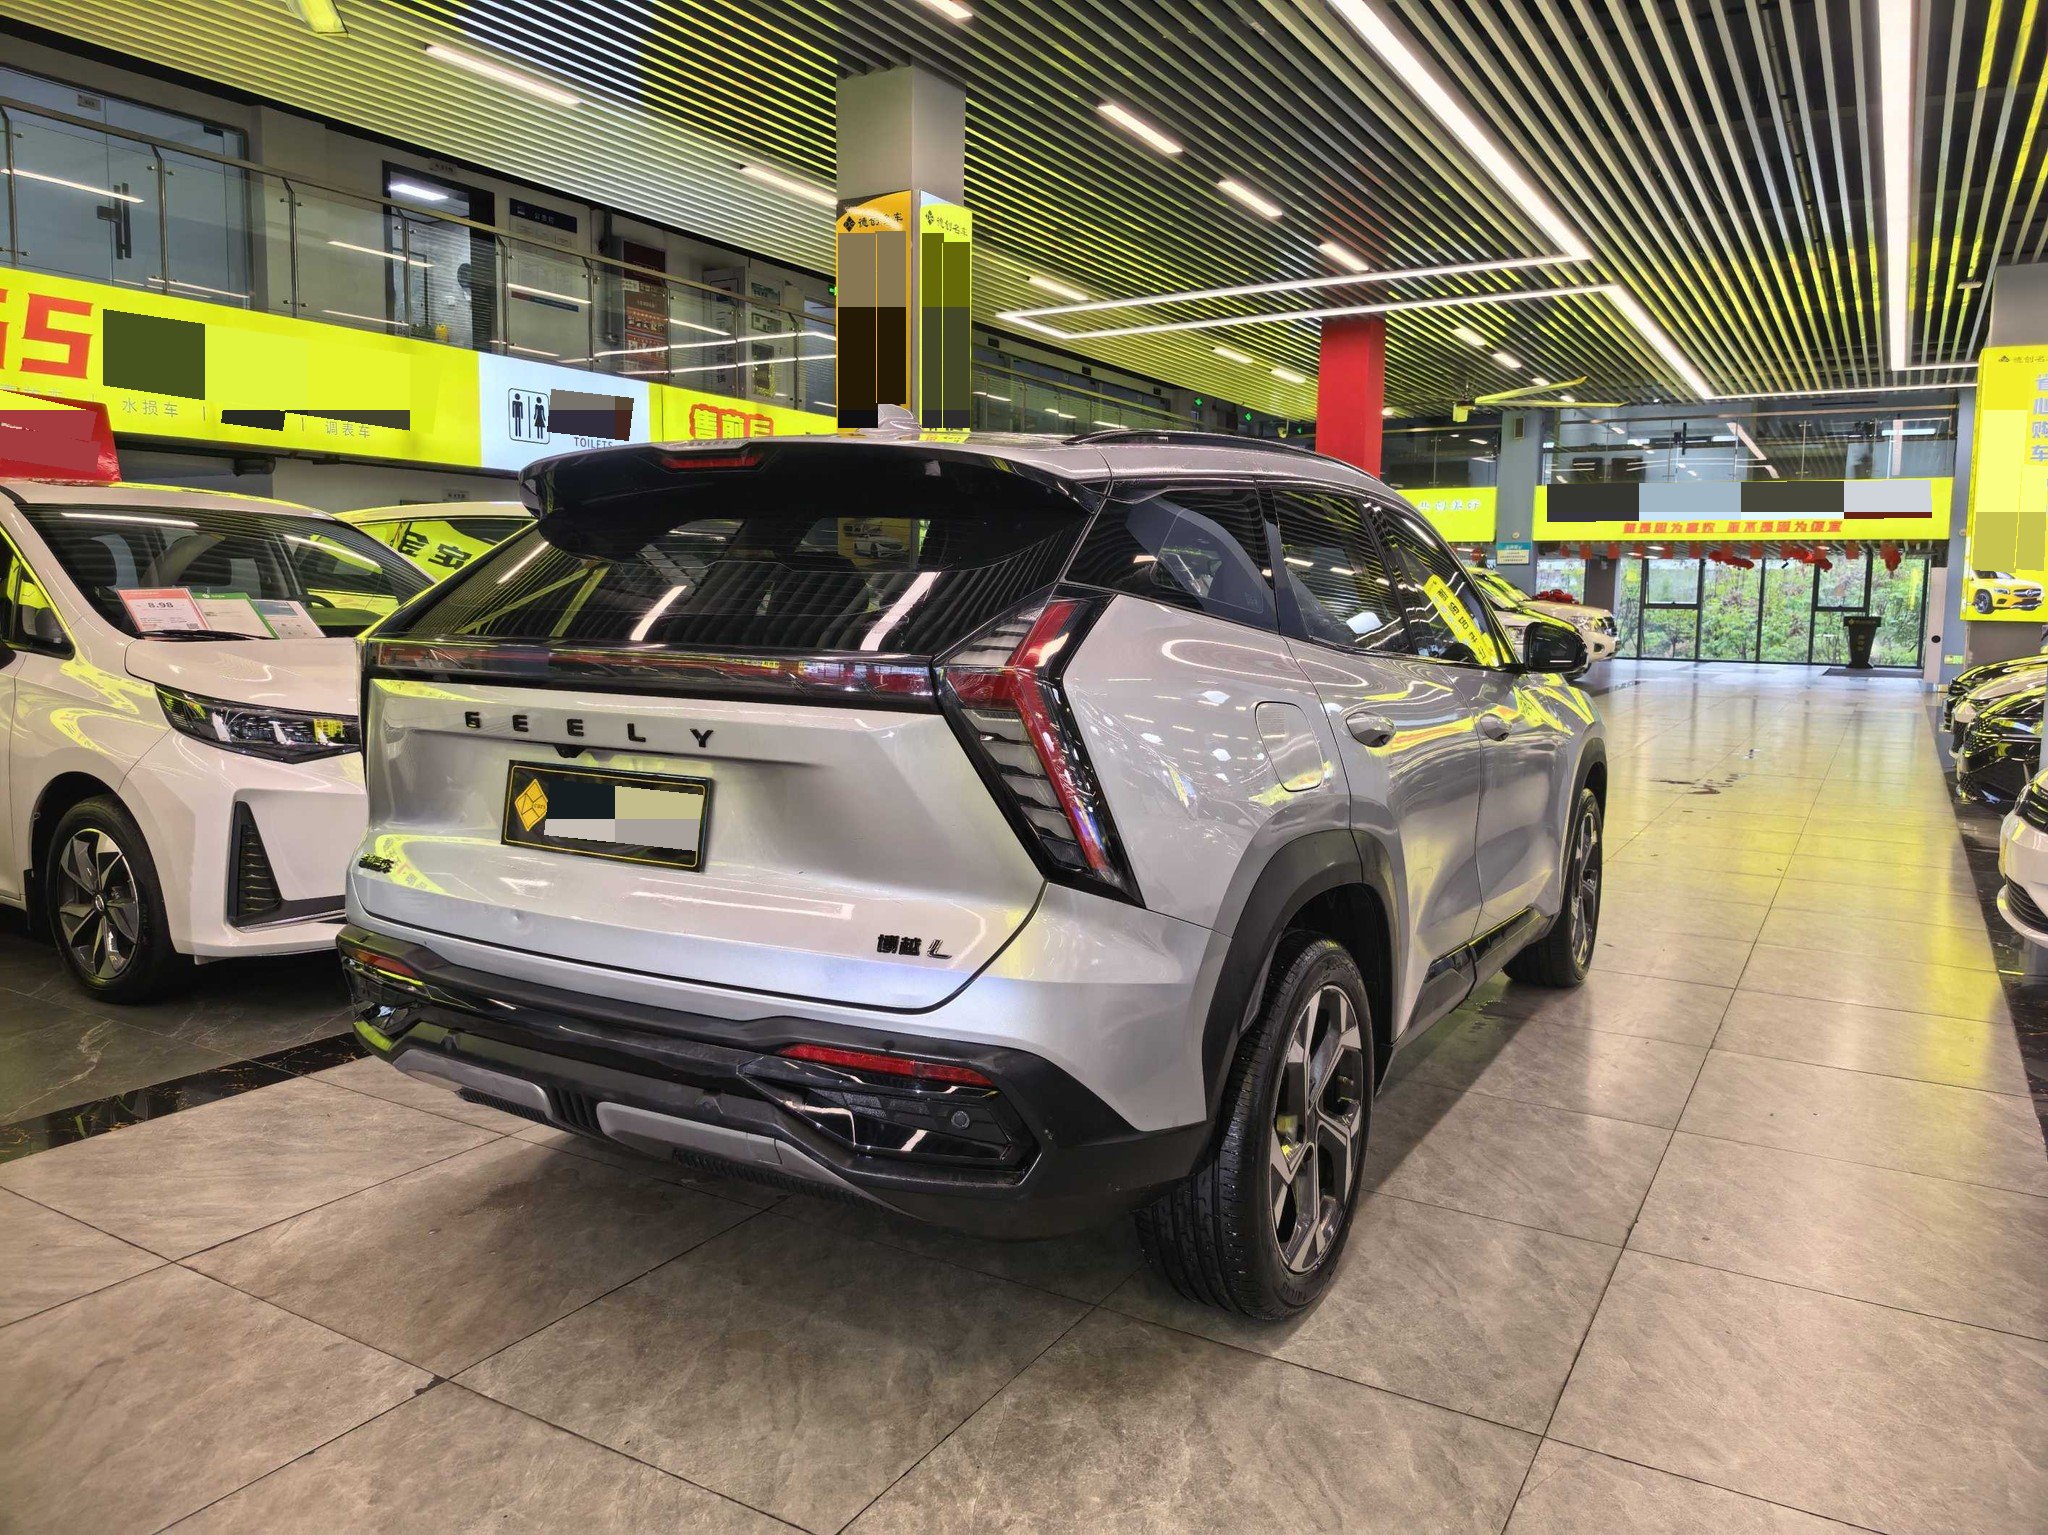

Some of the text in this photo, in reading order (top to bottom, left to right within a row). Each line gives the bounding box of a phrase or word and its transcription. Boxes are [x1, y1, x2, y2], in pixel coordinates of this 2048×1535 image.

[858, 211, 904, 229] 德创车
[122, 397, 178, 418] 水损车
[325, 420, 371, 439] 调表车
[573, 436, 613, 449] TOILETS
[464, 711, 714, 748] GEELY
